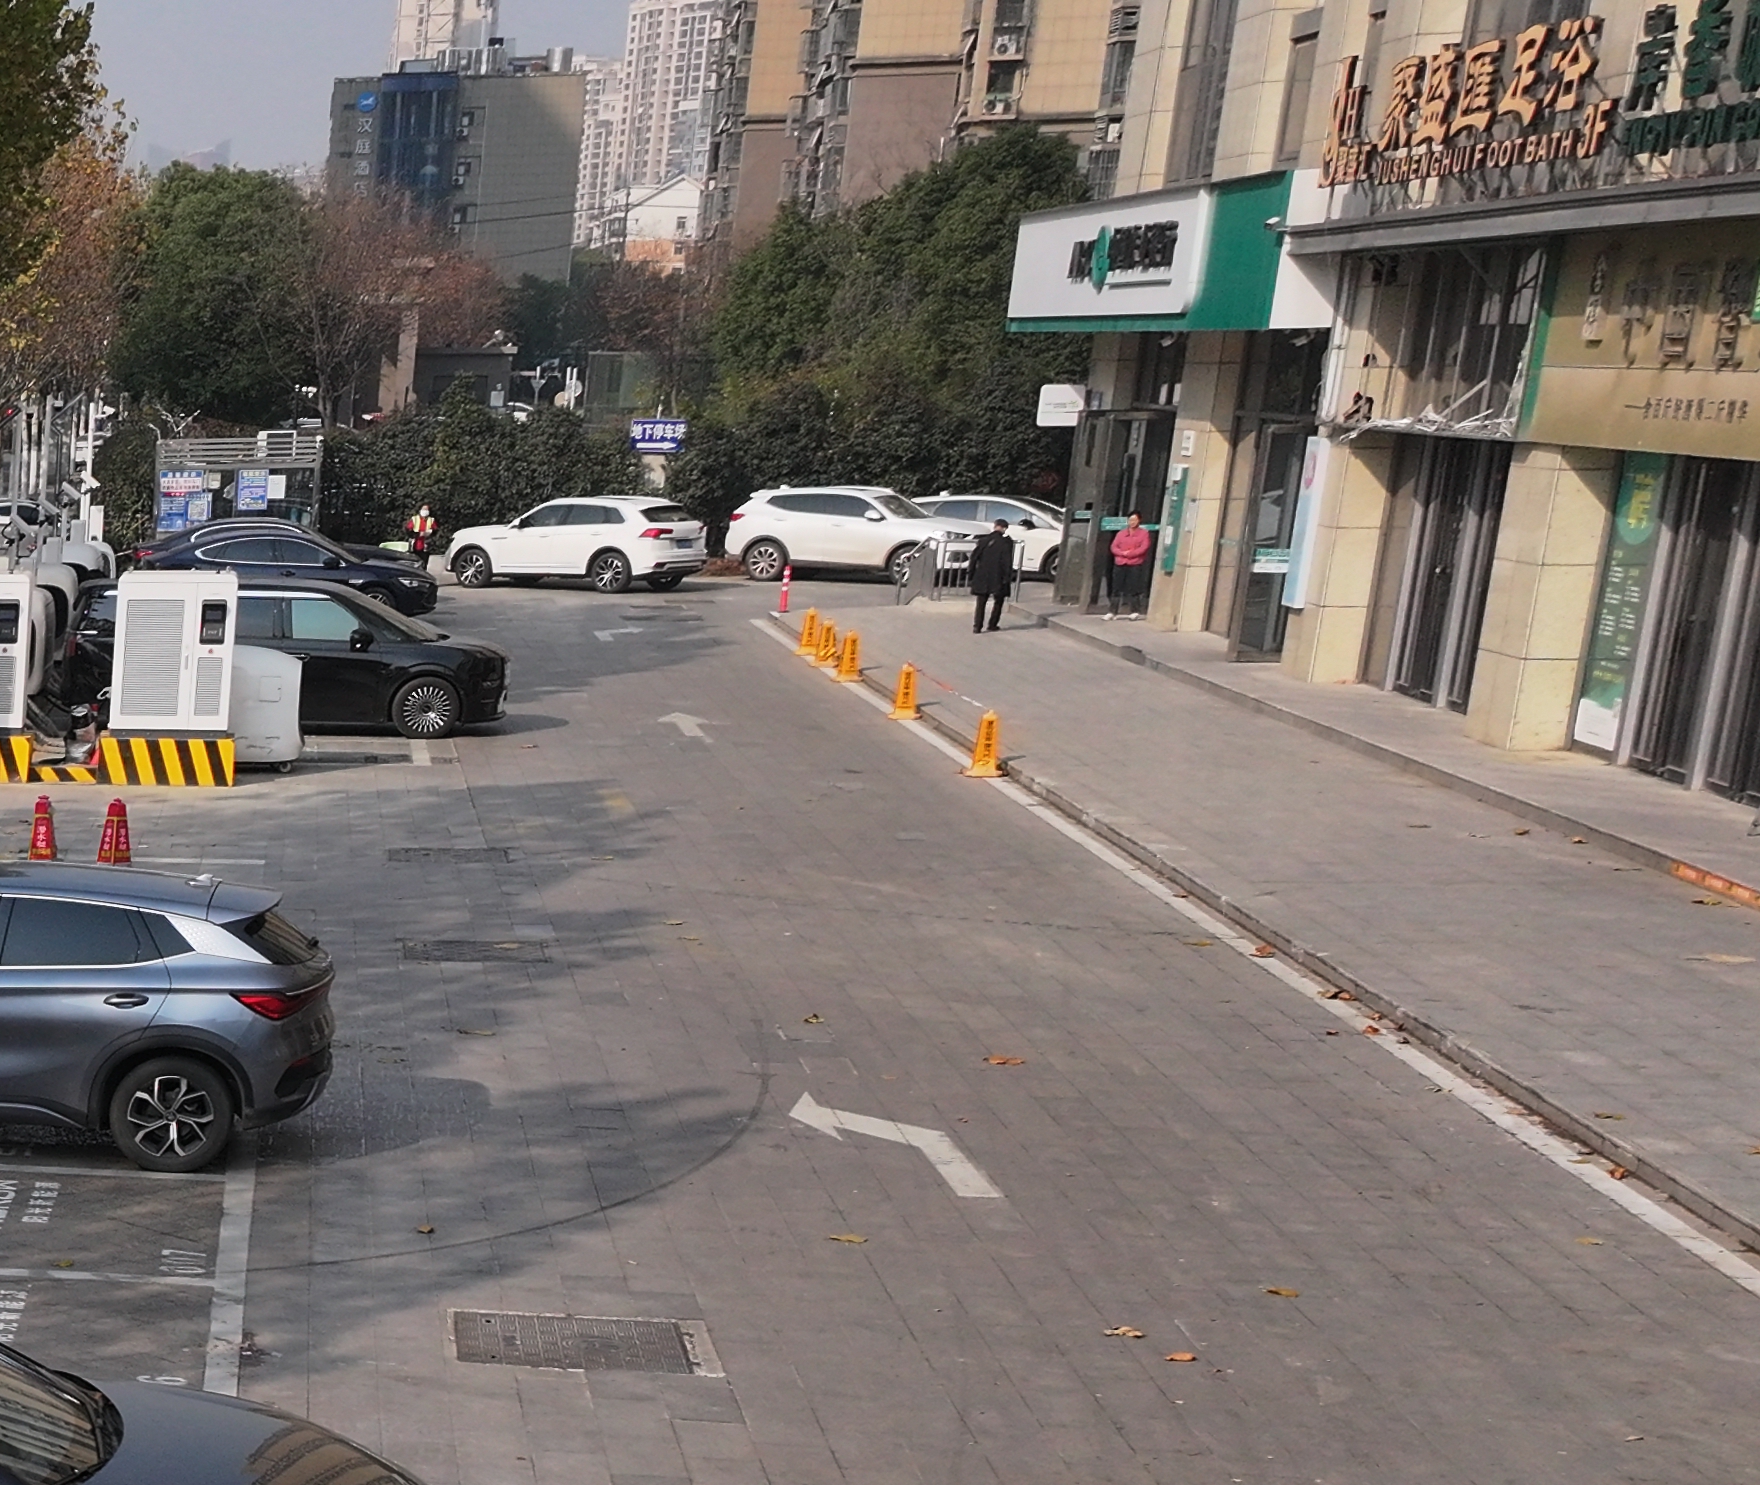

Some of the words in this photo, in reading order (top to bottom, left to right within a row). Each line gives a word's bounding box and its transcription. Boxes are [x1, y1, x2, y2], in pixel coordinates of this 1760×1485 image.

[353, 118, 372, 197] 汉庭酒店
[1376, 145, 1469, 186] JUSHENGHUI
[1472, 138, 1522, 171] FOOT
[1523, 130, 1574, 164] BATH
[1576, 100, 1612, 158] 3F
[631, 423, 687, 440] 地下停车场
